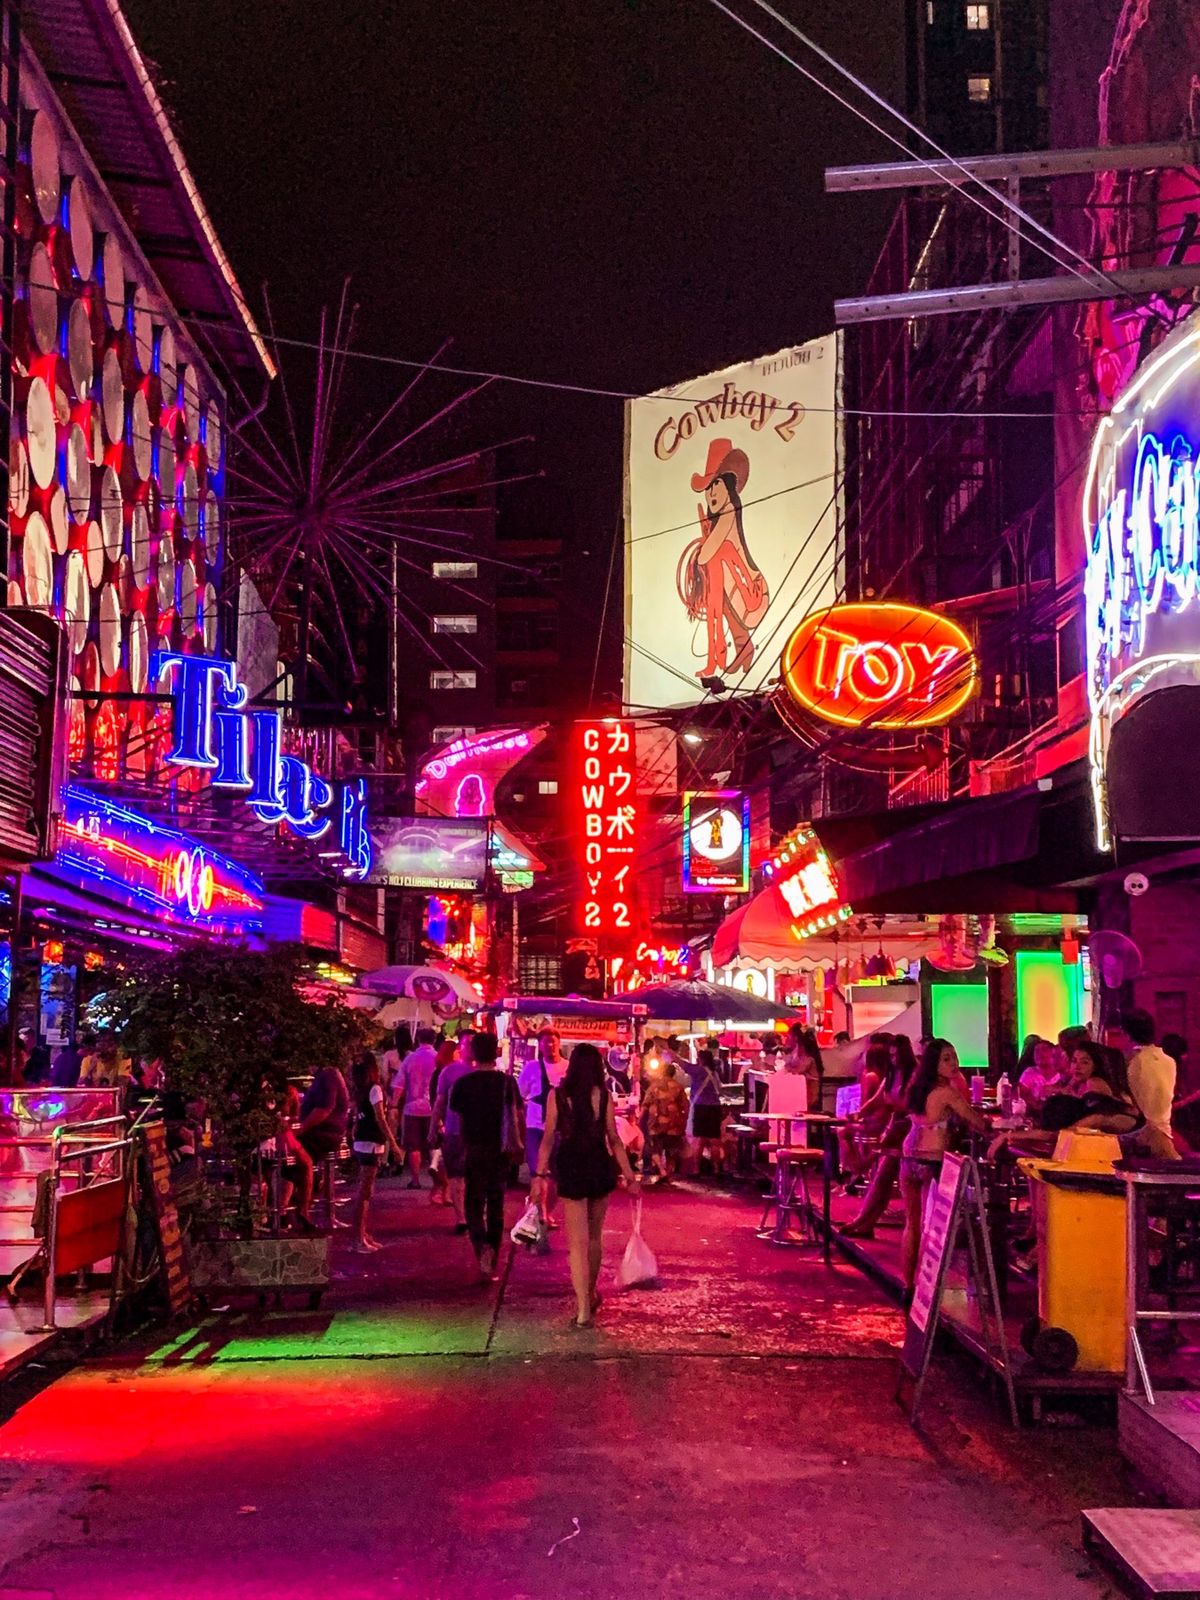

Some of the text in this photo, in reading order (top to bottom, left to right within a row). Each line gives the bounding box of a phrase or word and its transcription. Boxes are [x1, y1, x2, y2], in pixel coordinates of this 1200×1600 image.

[816, 345, 824, 360] 2
[654, 382, 806, 460] Cowboy 2
[813, 626, 959, 703] TOY
